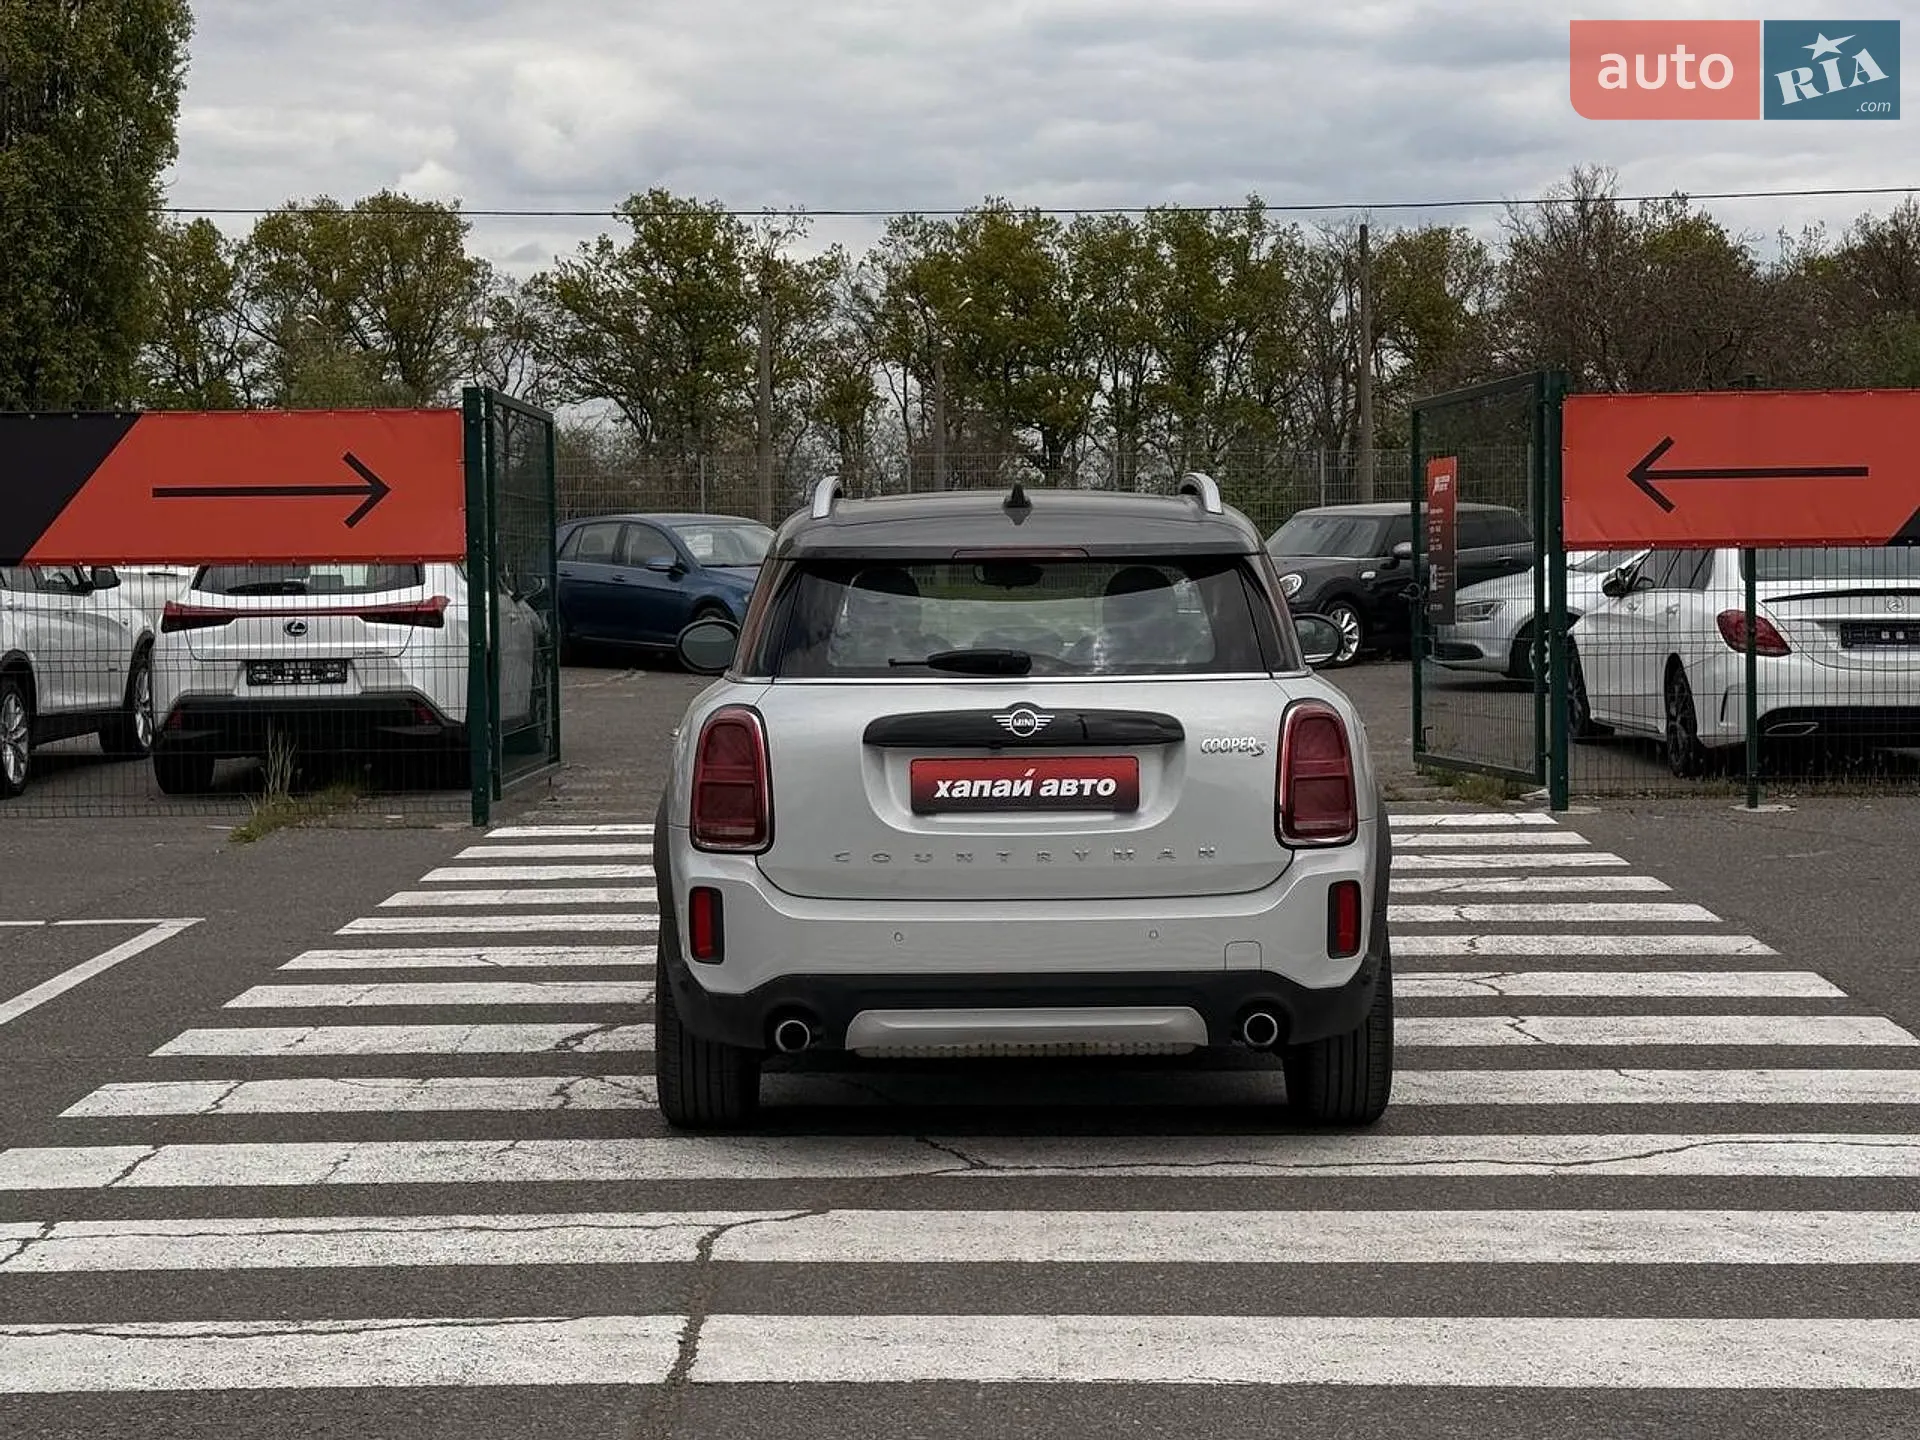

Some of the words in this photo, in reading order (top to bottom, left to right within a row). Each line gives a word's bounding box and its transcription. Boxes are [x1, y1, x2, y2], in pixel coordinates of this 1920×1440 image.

[1013, 718, 1035, 727] MINI
[1039, 777, 1117, 797] авто
[833, 847, 1217, 864] COUNTRYMAN
